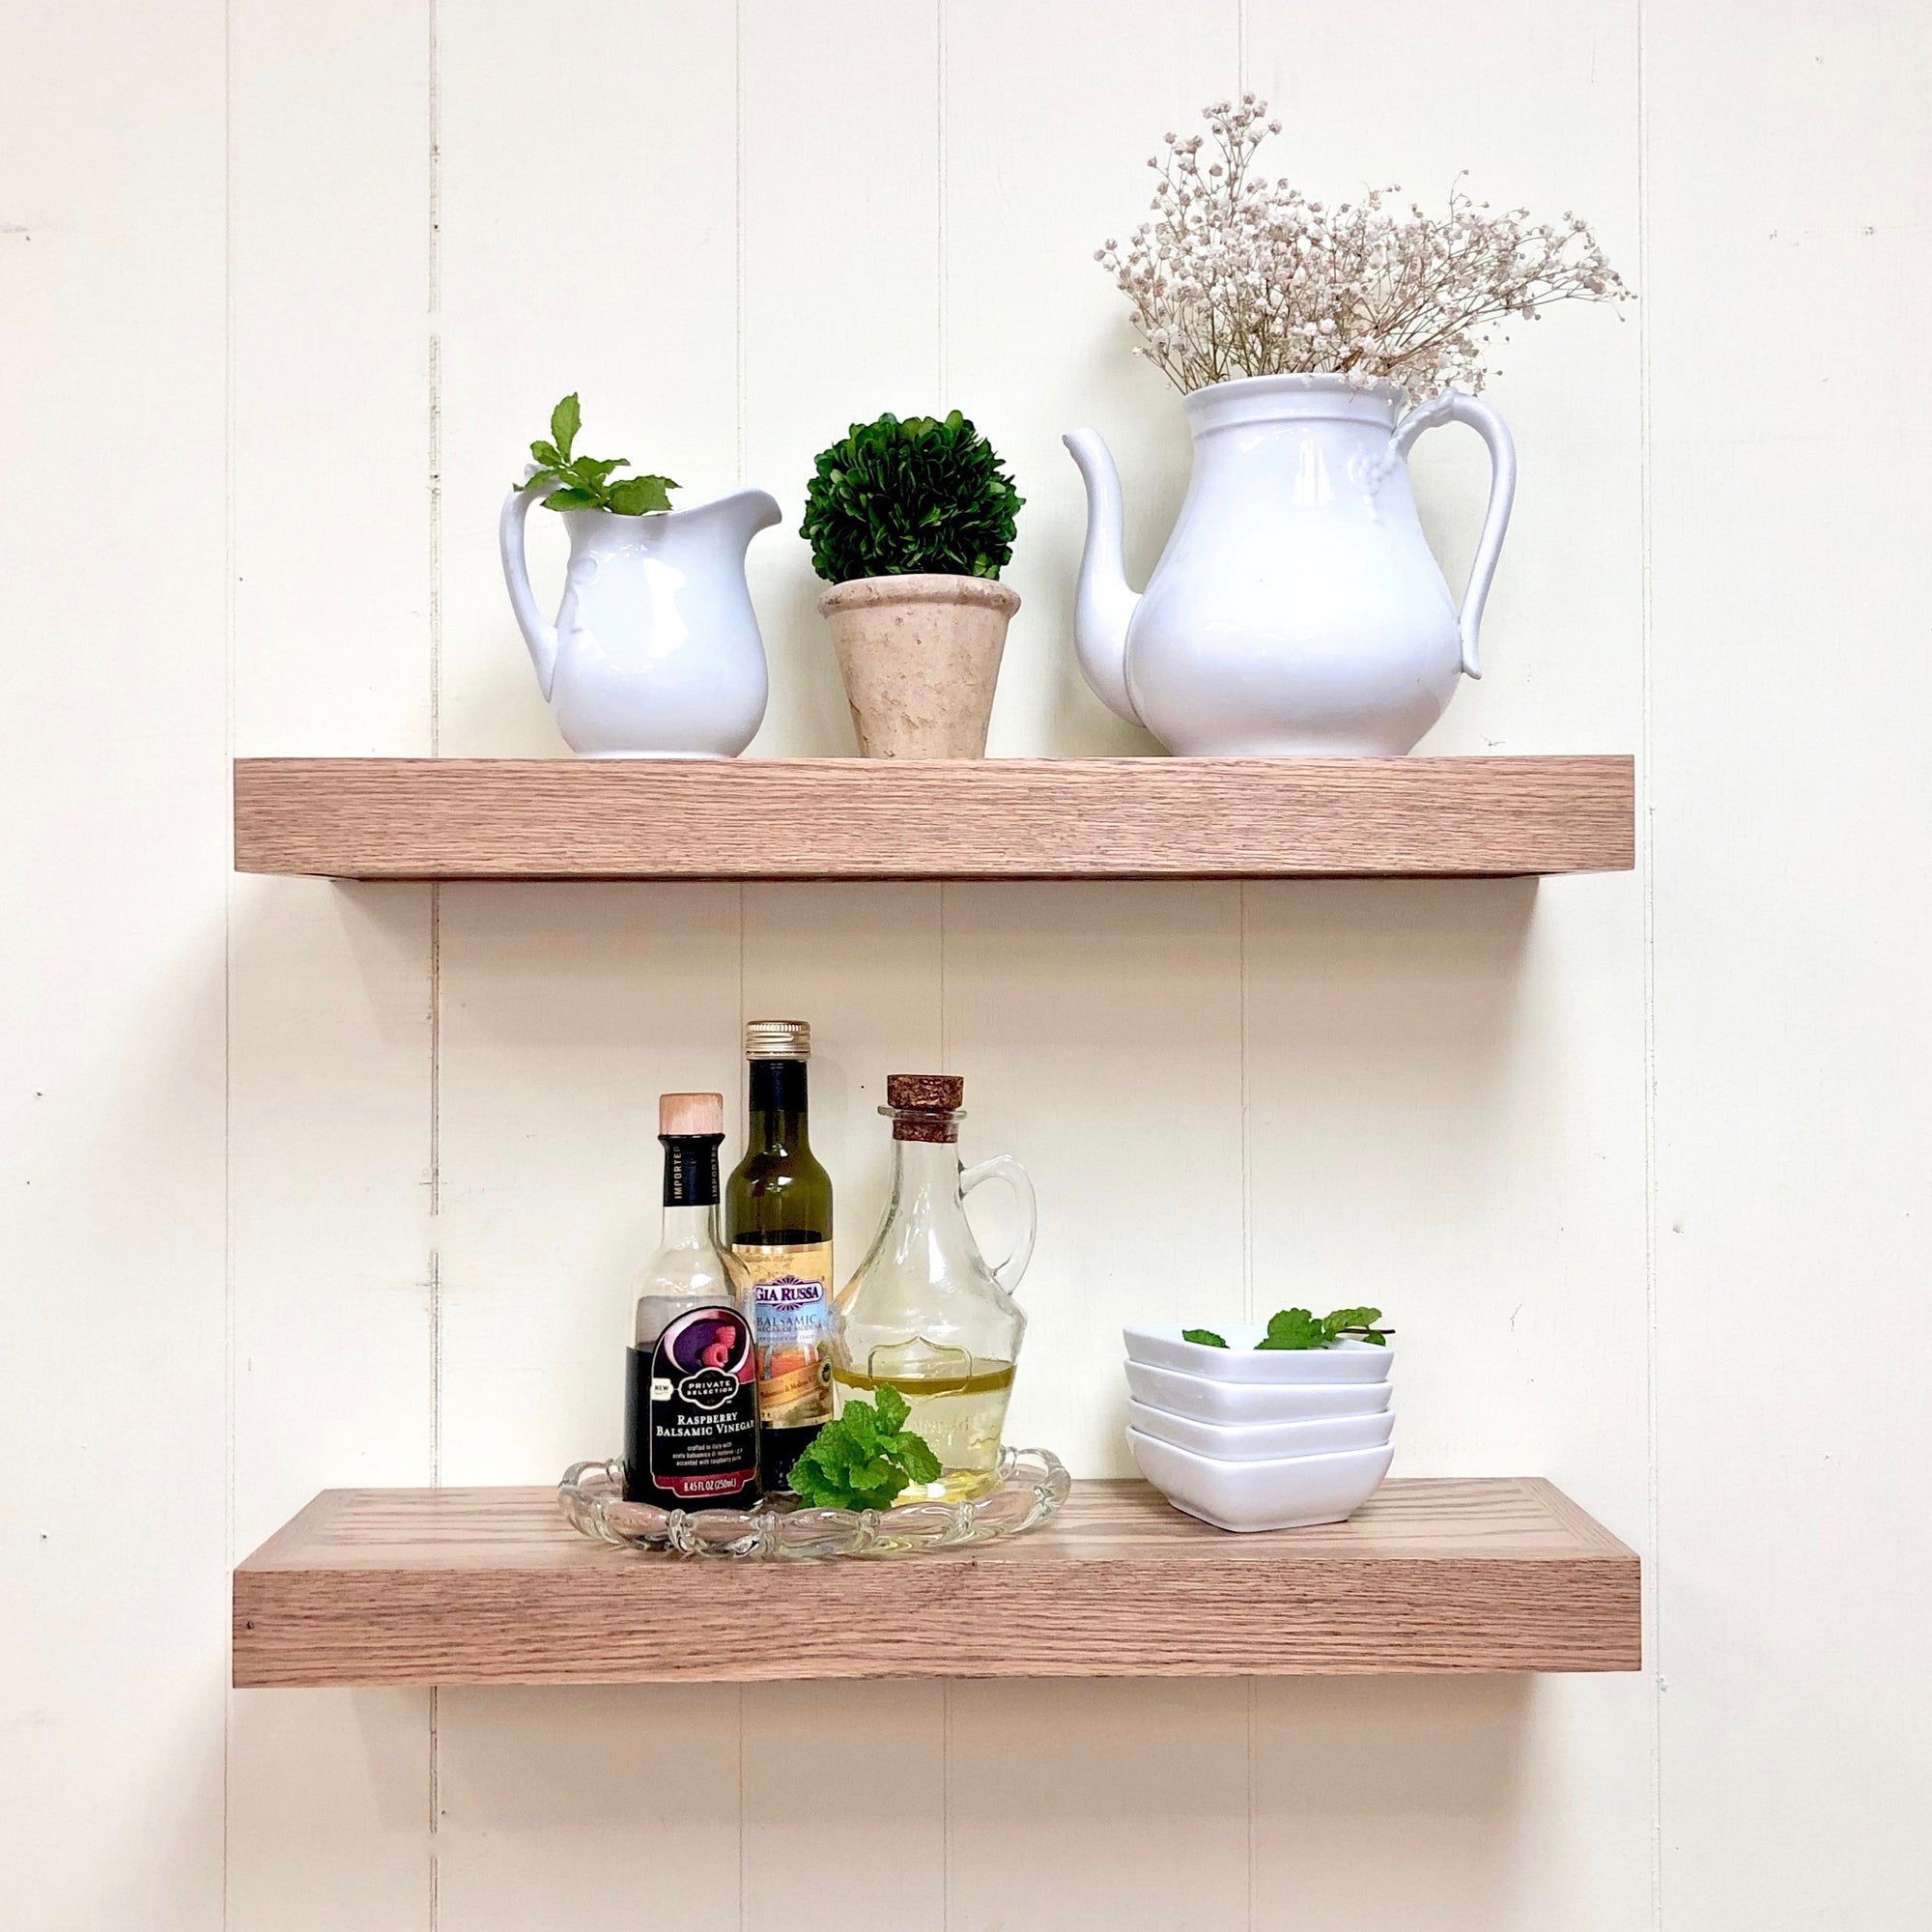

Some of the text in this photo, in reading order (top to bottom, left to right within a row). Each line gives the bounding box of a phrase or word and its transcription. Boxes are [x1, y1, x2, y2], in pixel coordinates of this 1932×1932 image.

[755, 1286, 819, 1301] GIA RUSSA
[756, 1314, 817, 1326] BALSAMIC
[688, 1379, 731, 1389] PRIVATE
[687, 1387, 733, 1396] SELECTION
[677, 1411, 738, 1426] RASPBERRY
[656, 1419, 754, 1437] BALSAMIC VINEGAR
[684, 1481, 696, 1492] 8.45
[697, 1481, 705, 1492] FL
[705, 1480, 715, 1491] OZ
